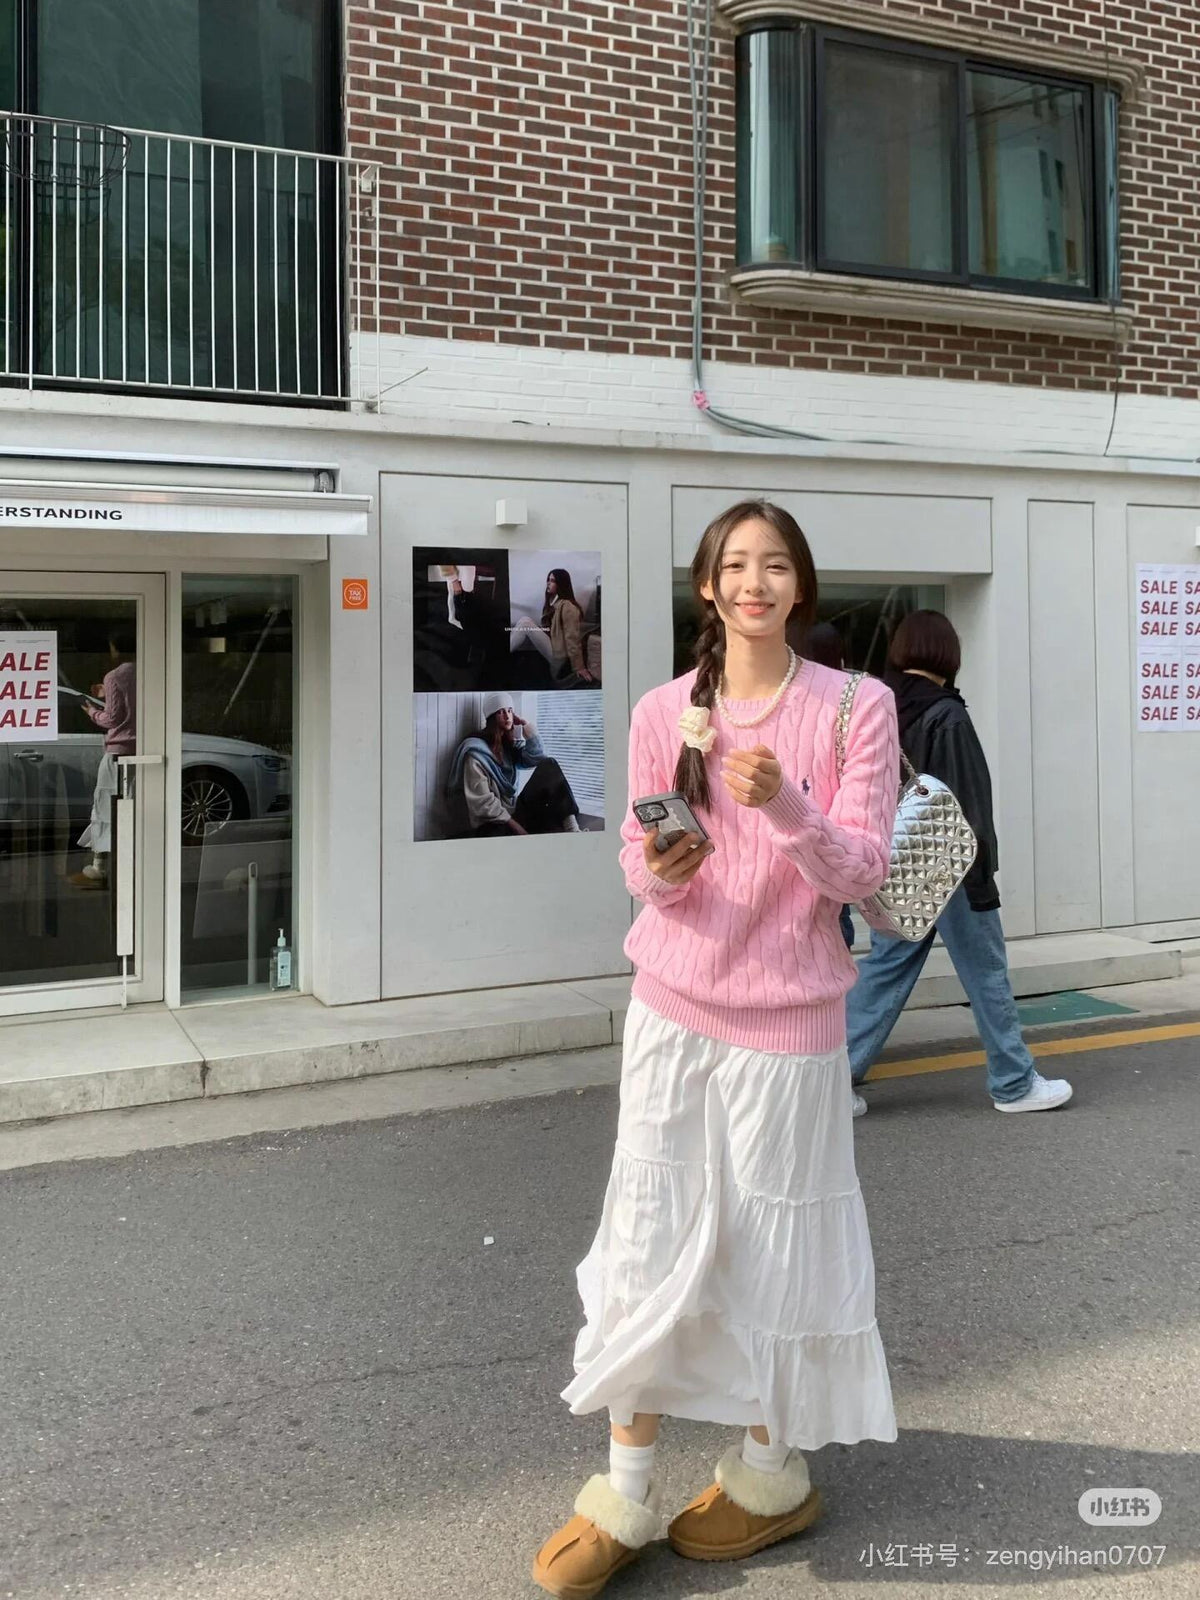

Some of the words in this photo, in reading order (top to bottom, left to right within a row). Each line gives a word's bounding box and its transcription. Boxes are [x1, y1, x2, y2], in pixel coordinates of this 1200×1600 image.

[0, 506, 122, 520] RSTANDING
[1140, 579, 1178, 594] SALE
[1141, 600, 1179, 615] SALE
[1140, 621, 1179, 636] SALE
[1141, 663, 1179, 678] SALE
[1141, 685, 1179, 699] SALE
[1141, 706, 1178, 720] SALE
